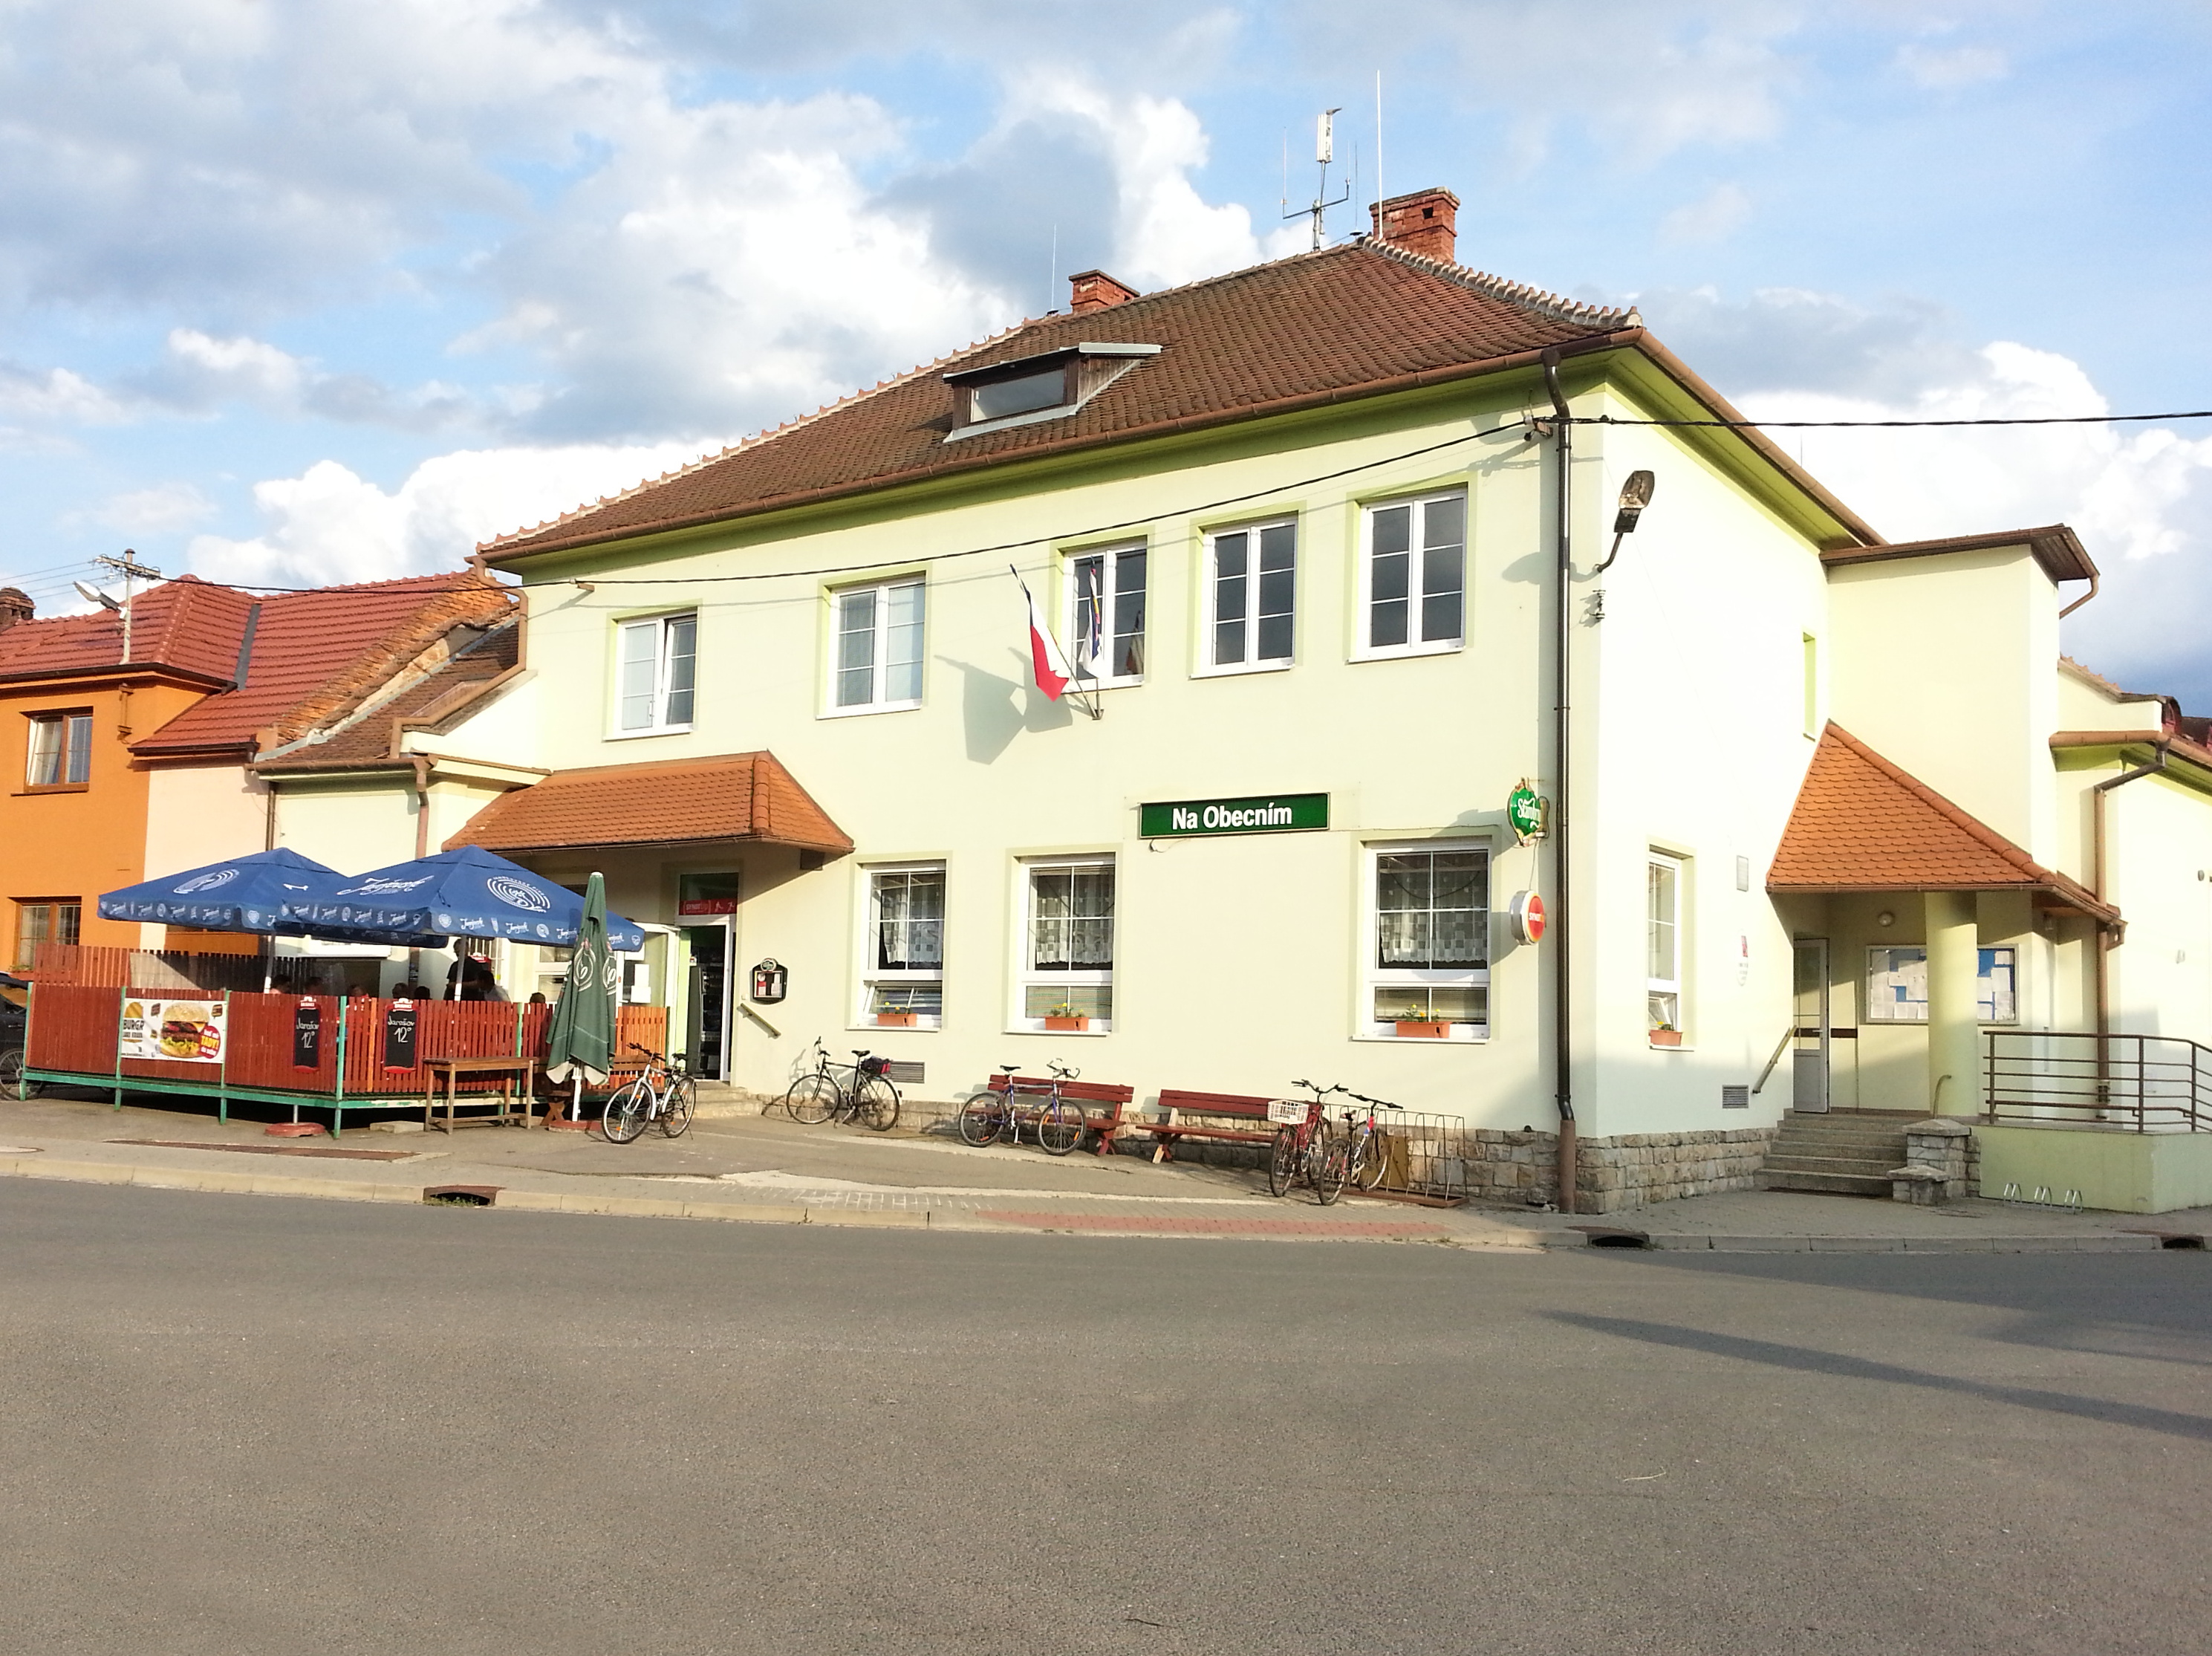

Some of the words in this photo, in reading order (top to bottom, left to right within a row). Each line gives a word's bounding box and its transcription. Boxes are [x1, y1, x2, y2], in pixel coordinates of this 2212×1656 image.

[1172, 808, 1197, 830] Na
[1203, 802, 1292, 828] Obecním
[301, 1030, 315, 1048] 12°
[394, 1027, 412, 1042] 12°
